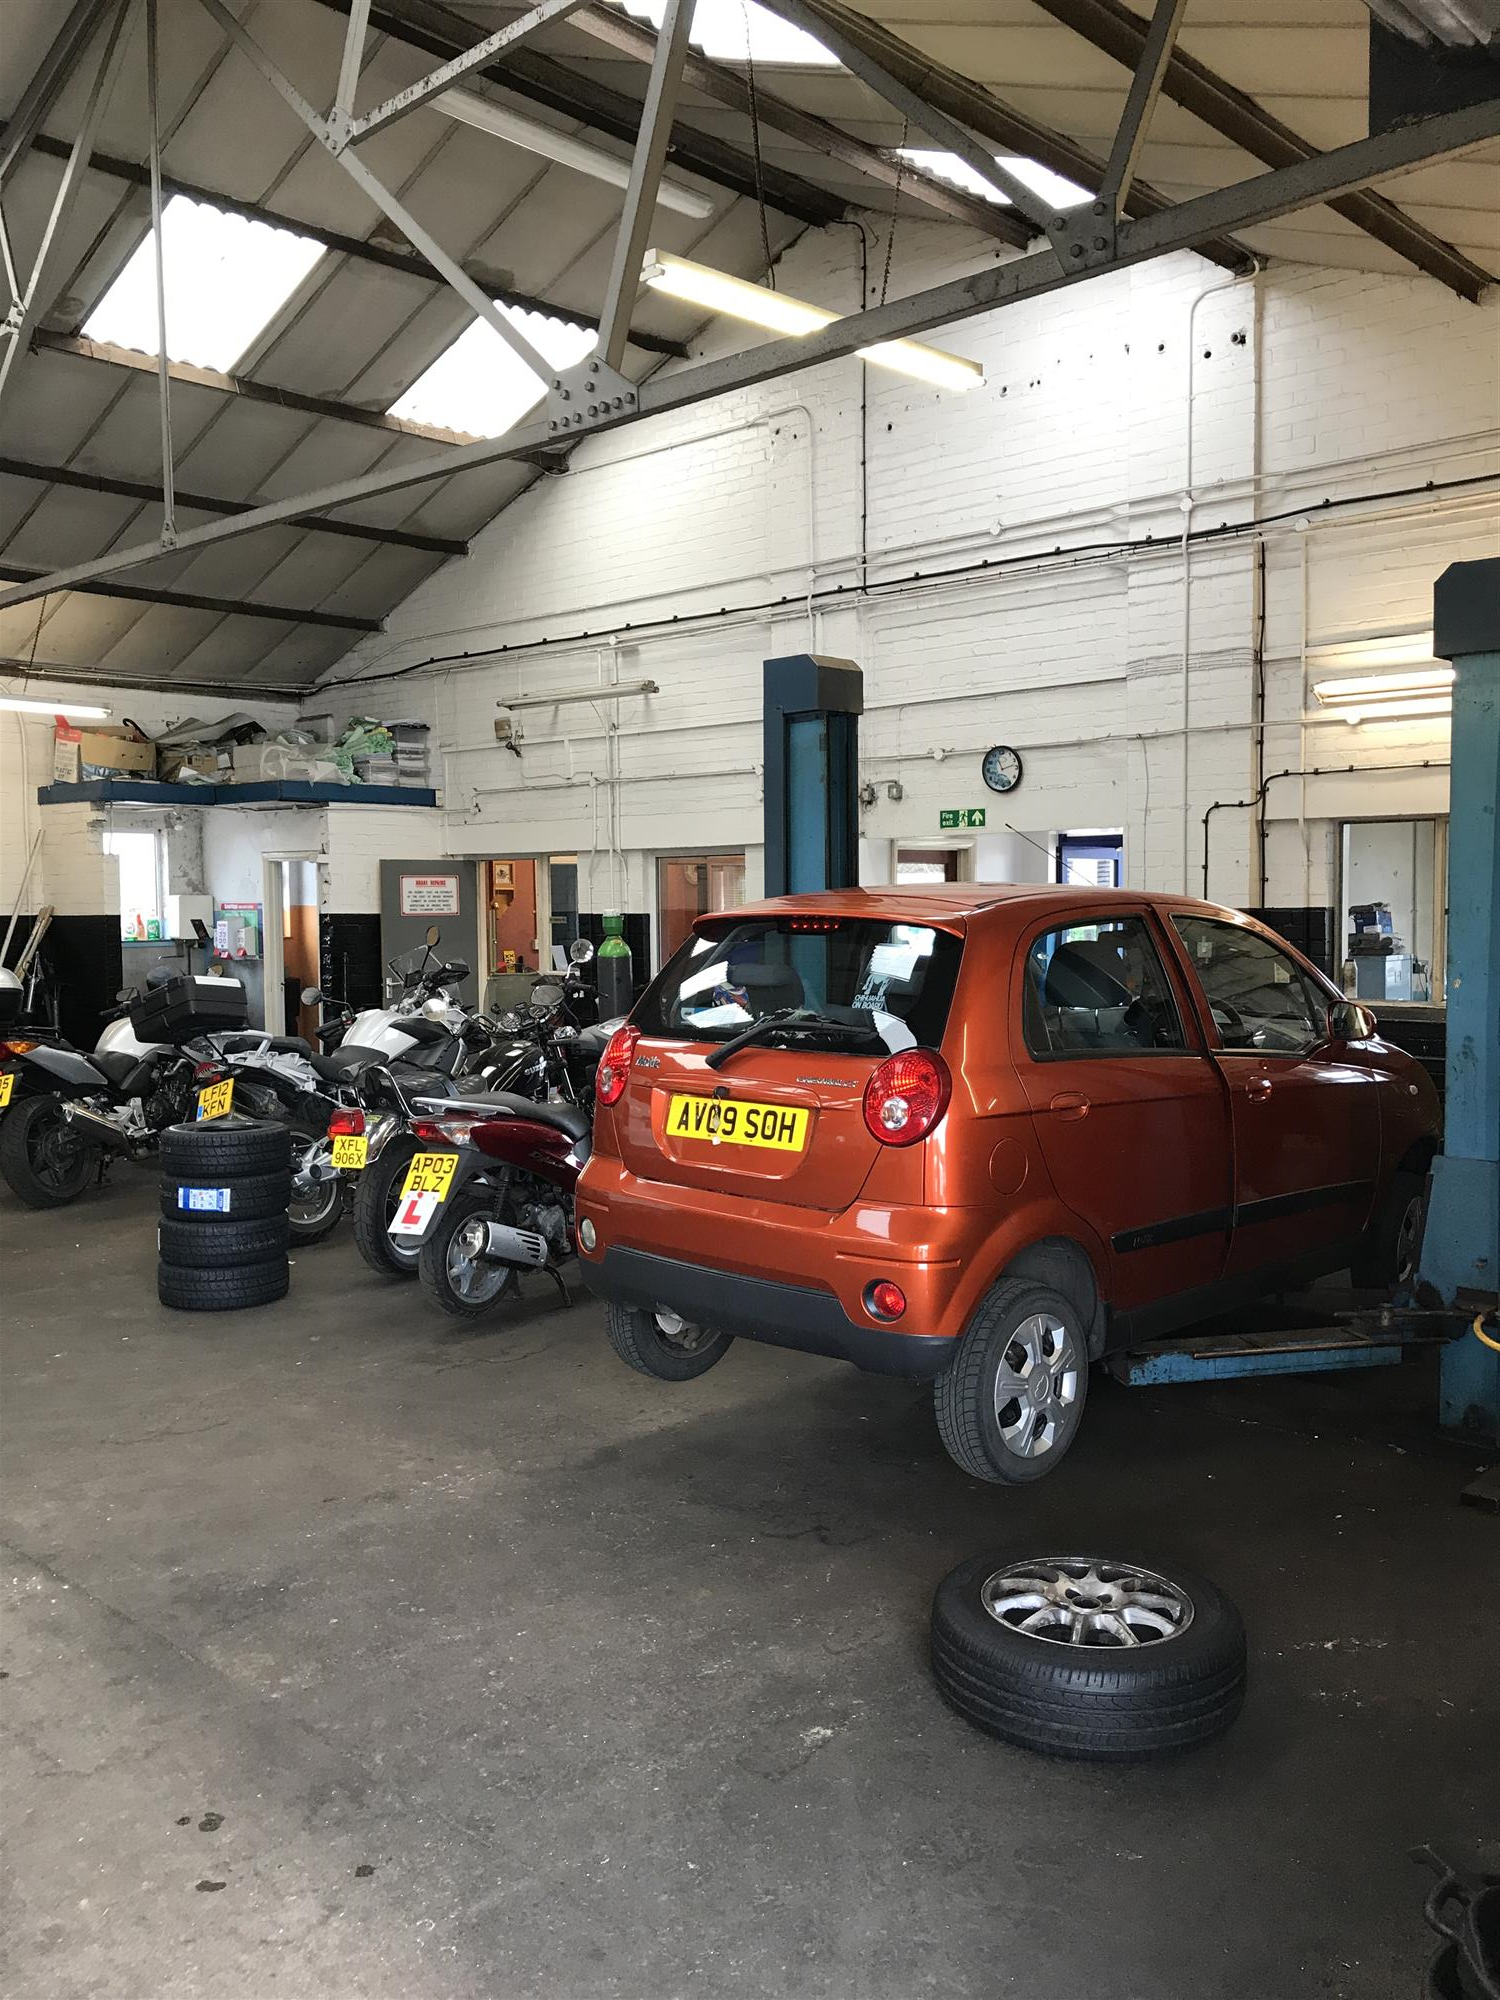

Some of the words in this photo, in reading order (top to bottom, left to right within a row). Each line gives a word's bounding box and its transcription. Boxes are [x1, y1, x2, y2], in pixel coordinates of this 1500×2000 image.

[852, 1001, 861, 1009] ON
[854, 994, 886, 1002] CHIHUAHUA
[204, 1082, 229, 1103] LF12
[203, 1097, 226, 1118] KFN
[676, 1101, 738, 1136] AV09
[743, 1108, 797, 1144] SOH
[339, 1138, 362, 1152] XFL
[334, 1152, 363, 1165] 906X
[410, 1157, 455, 1174] AP03
[409, 1175, 444, 1193] BLZ
[401, 1199, 421, 1225] L
